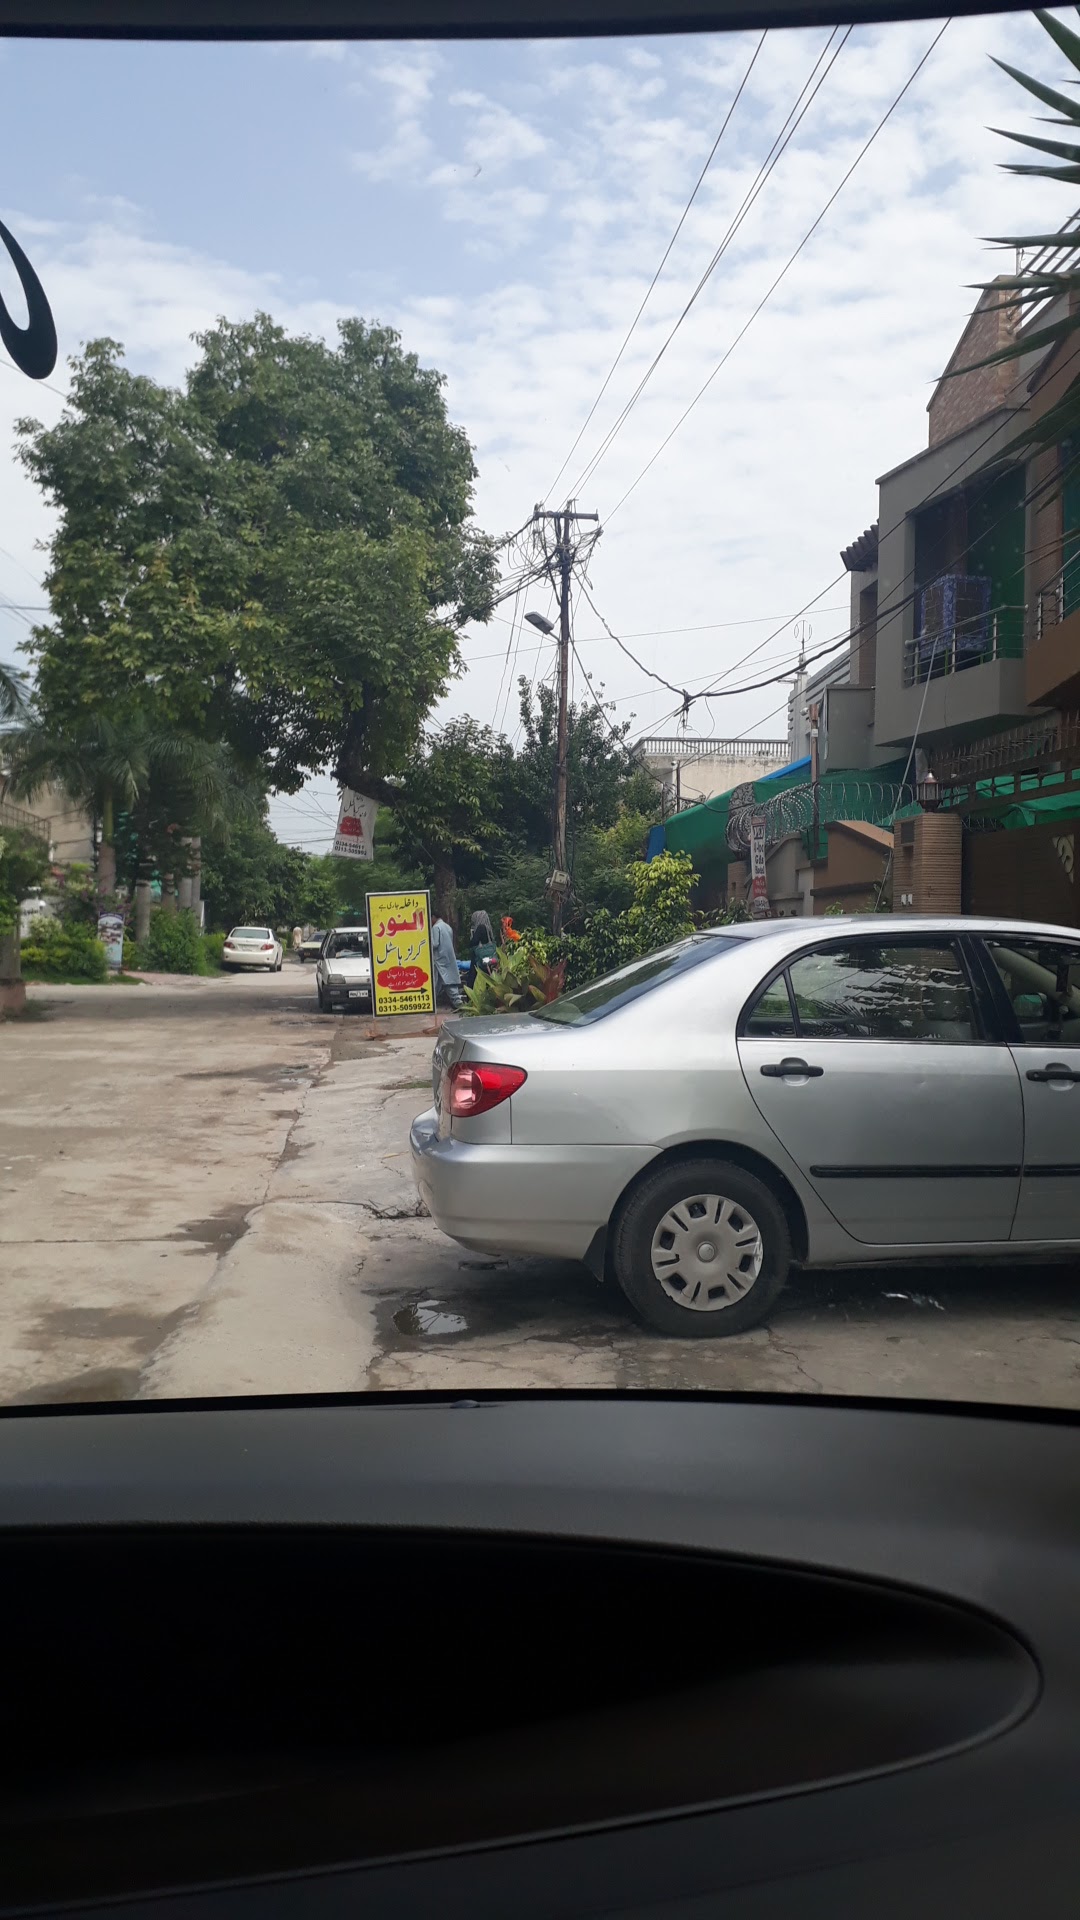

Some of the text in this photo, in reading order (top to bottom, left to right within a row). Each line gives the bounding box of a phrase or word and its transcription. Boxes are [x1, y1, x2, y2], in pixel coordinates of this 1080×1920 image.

[378, 898, 419, 912] داخلہ جاری ہے
[375, 909, 425, 938] النور
[376, 939, 426, 966] گرلز ہاسٹل
[379, 994, 430, 1004] 0334-5461113
[379, 1003, 431, 1013] 0313-5059922
